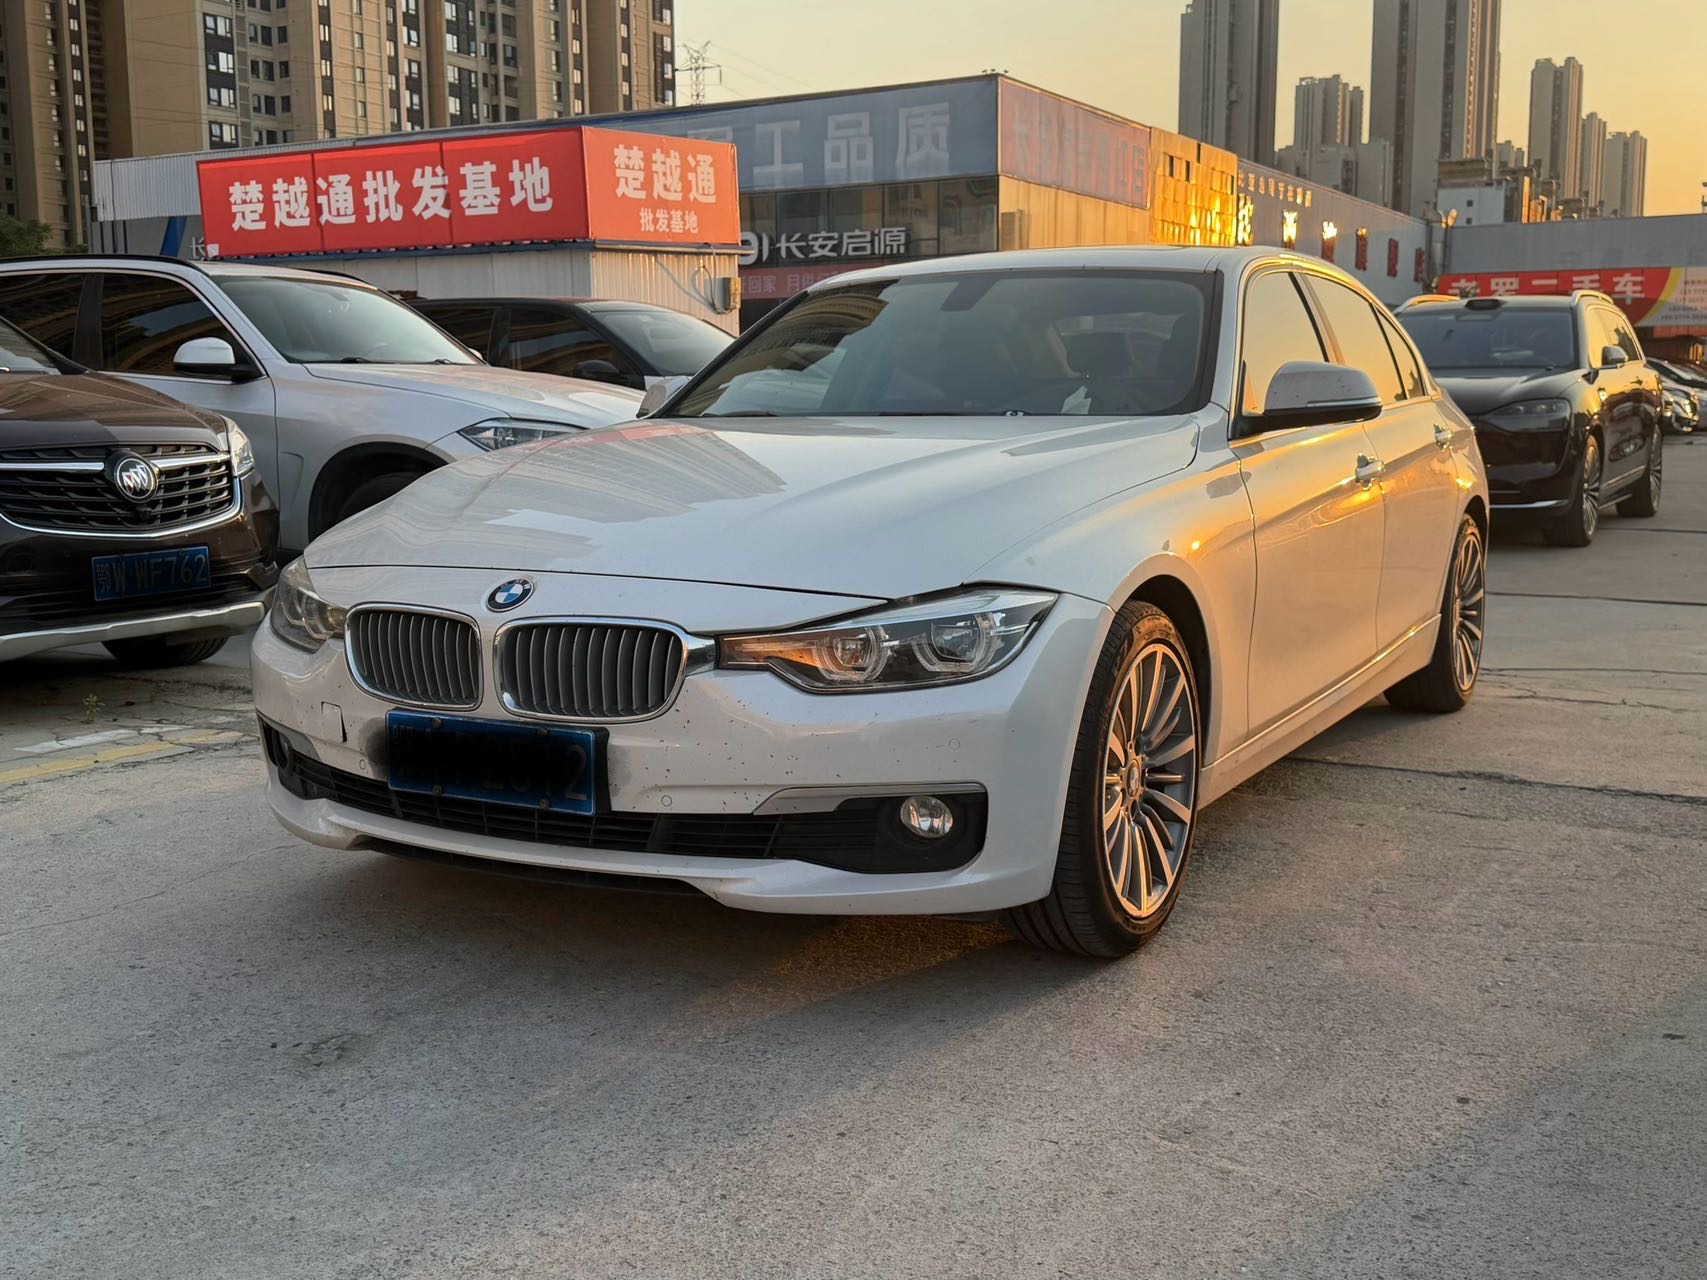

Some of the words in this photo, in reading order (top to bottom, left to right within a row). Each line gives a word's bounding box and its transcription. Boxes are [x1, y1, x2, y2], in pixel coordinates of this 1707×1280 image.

[687, 102, 950, 170] 工品质
[229, 157, 553, 231] 楚越通批发基地
[613, 143, 717, 204] 楚越通
[639, 208, 699, 234] 批发基地
[775, 227, 907, 259] 长安启源
